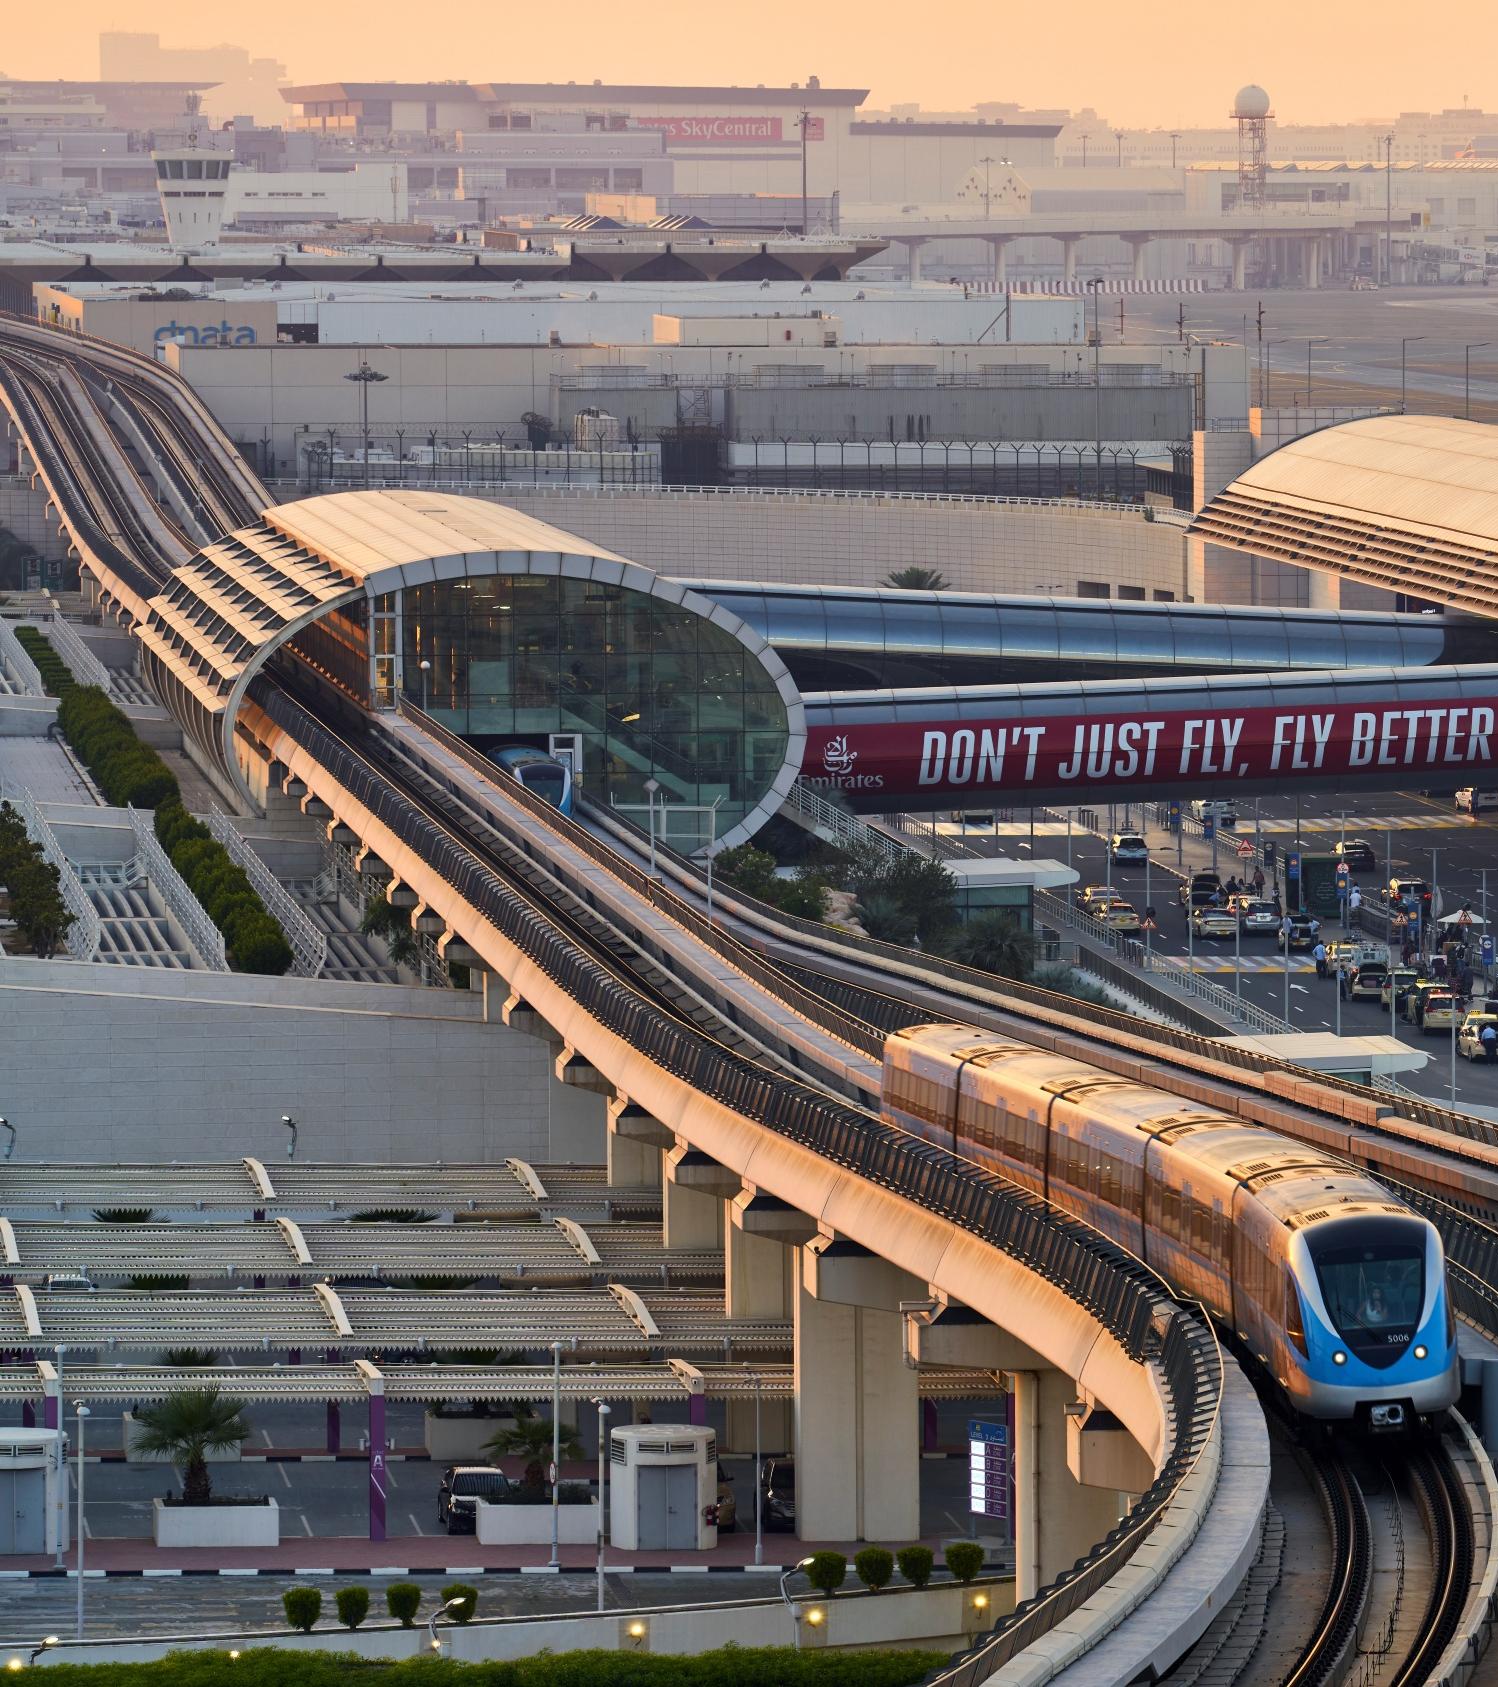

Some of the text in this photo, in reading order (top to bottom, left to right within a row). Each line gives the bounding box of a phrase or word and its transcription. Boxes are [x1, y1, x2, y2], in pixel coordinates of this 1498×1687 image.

[681, 120, 772, 139] SkyCentral
[154, 320, 256, 344] dnata
[918, 706, 1496, 785] DON'T JUST FLY, FLY BETTER
[798, 773, 884, 789] Emirates
[1387, 1333, 1410, 1343] 5006
[373, 1454, 383, 1467] A
